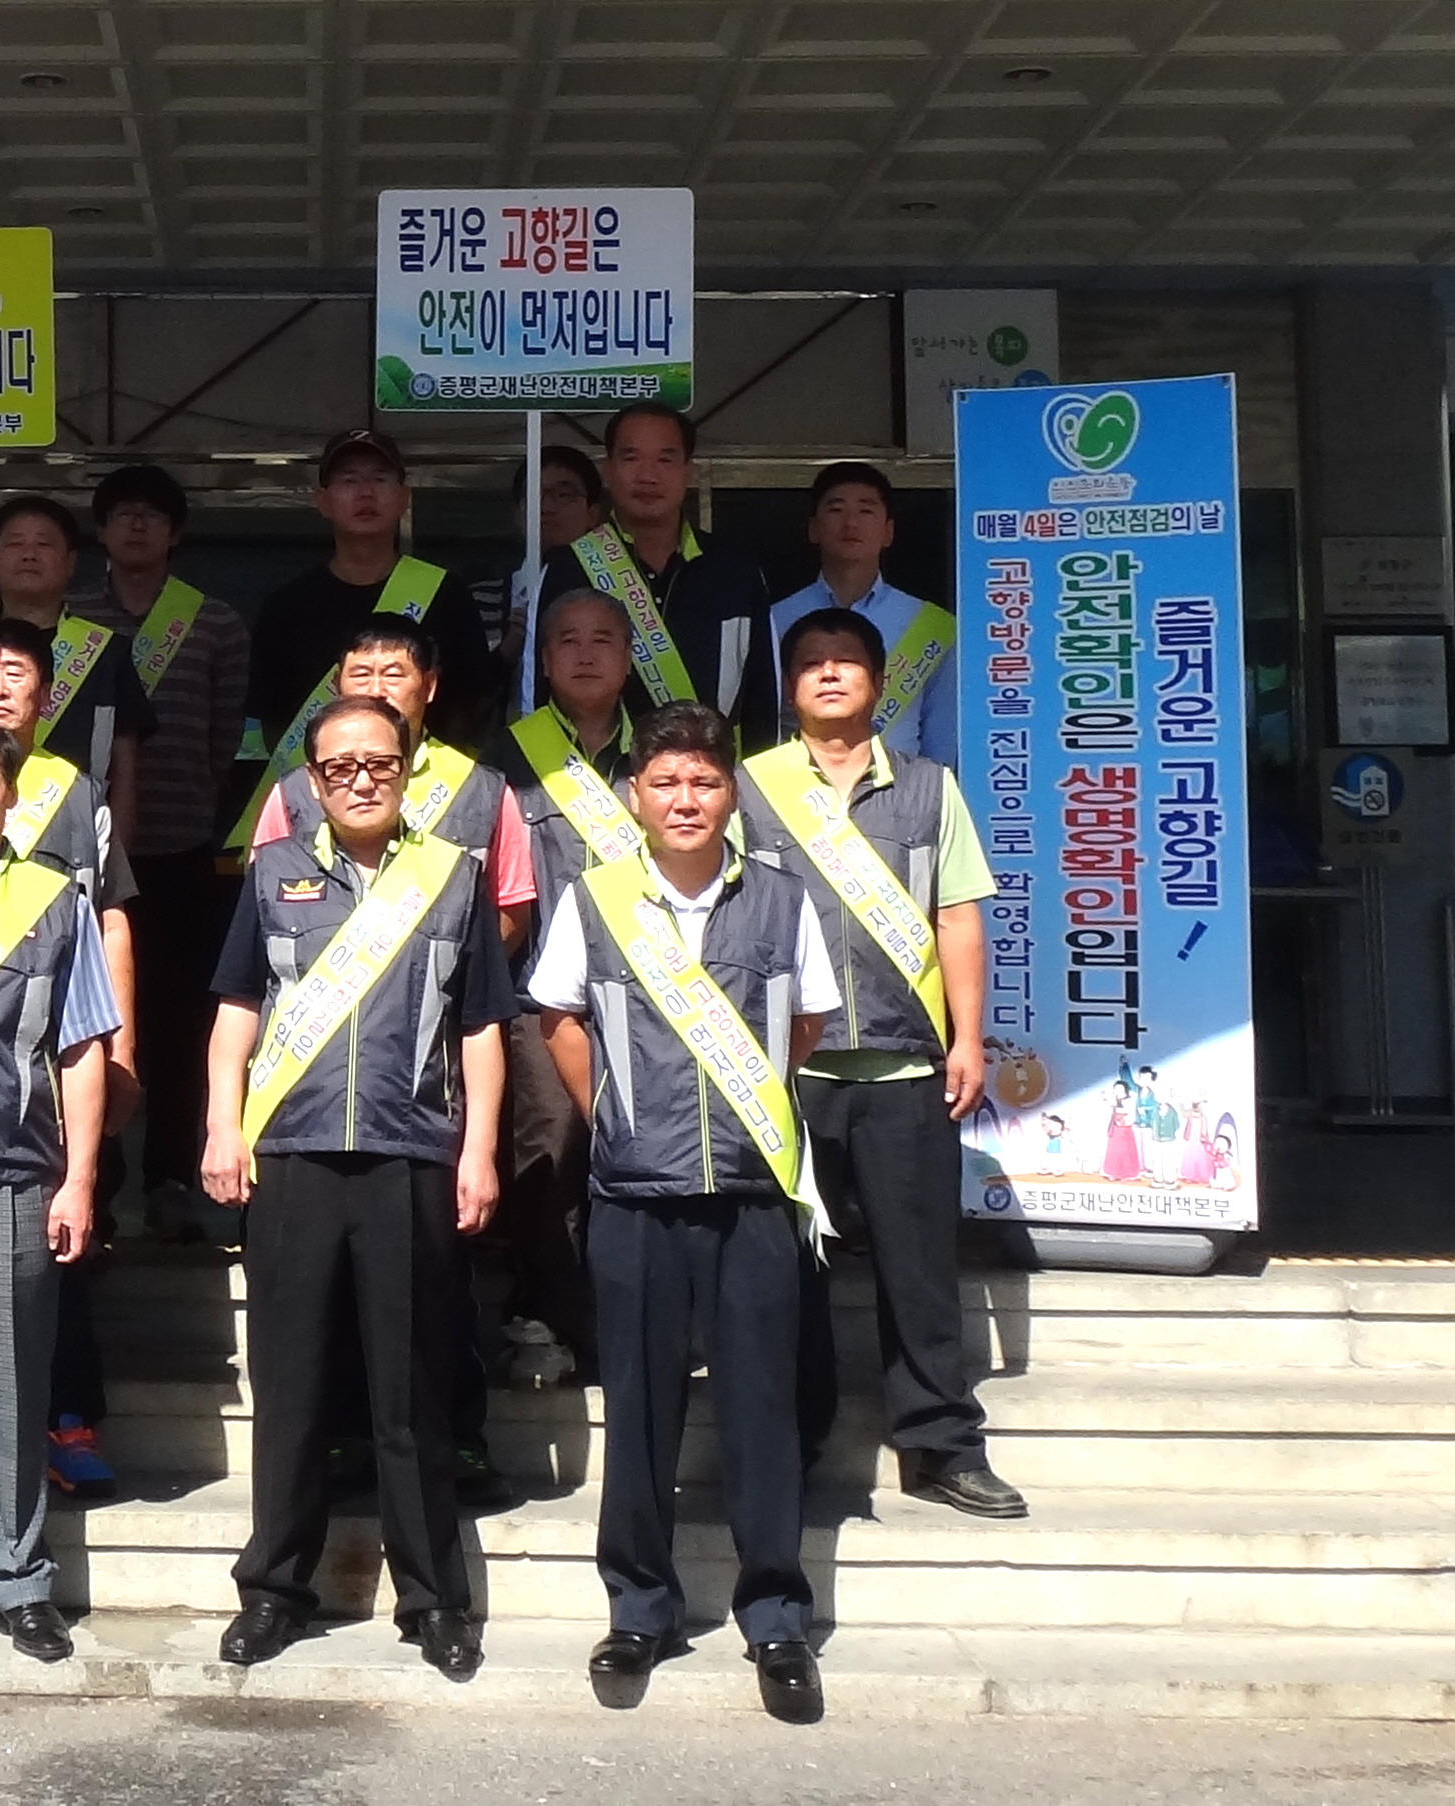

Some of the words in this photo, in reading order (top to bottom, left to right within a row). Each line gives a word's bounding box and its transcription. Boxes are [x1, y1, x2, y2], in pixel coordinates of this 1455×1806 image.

[399, 206, 486, 273] 즐거운
[500, 206, 620, 275] 고향길은
[419, 290, 505, 355] 안전이
[521, 290, 673, 356] 먼저입니다
[439, 375, 659, 397] 증평군재난안전대책본부
[977, 513, 1017, 538] 매월
[1024, 512, 1077, 537] 4일은
[1085, 505, 1191, 535] 안전점검의
[1200, 503, 1221, 529] 날
[577, 540, 616, 591] 안전이
[147, 619, 186, 674] 즐거운
[617, 569, 670, 652] 고향길은
[987, 561, 1032, 716] 고향방문을
[1058, 552, 1140, 749] 안전확인은
[67, 629, 105, 678] 즐거운
[900, 640, 942, 695] 장시간
[1154, 600, 1217, 742] 즐거운
[39, 680, 73, 723] 명절
[29, 782, 59, 820] 가스
[564, 754, 617, 817] 장시간
[990, 730, 1033, 855] 진심으로
[806, 790, 844, 835] 가스
[844, 839, 930, 947] 안전점검은
[1158, 762, 1222, 906] 고향길
[369, 889, 425, 959] 즐거운
[811, 837, 867, 901] 행복의
[867, 907, 923, 974] 지름길
[1060, 767, 1148, 1049] 생명확인입니다
[636, 900, 690, 974] 즐거운
[688, 979, 770, 1084] 고향길은
[992, 872, 1035, 1033] 환영합니다
[252, 977, 329, 1089] 먼저입니다
[291, 966, 369, 1062] 고향길은
[630, 942, 691, 1016] 안전이
[690, 1022, 784, 1154] 먼저입니다
[1021, 1190, 1231, 1218] 증평군재난안전대책본부
